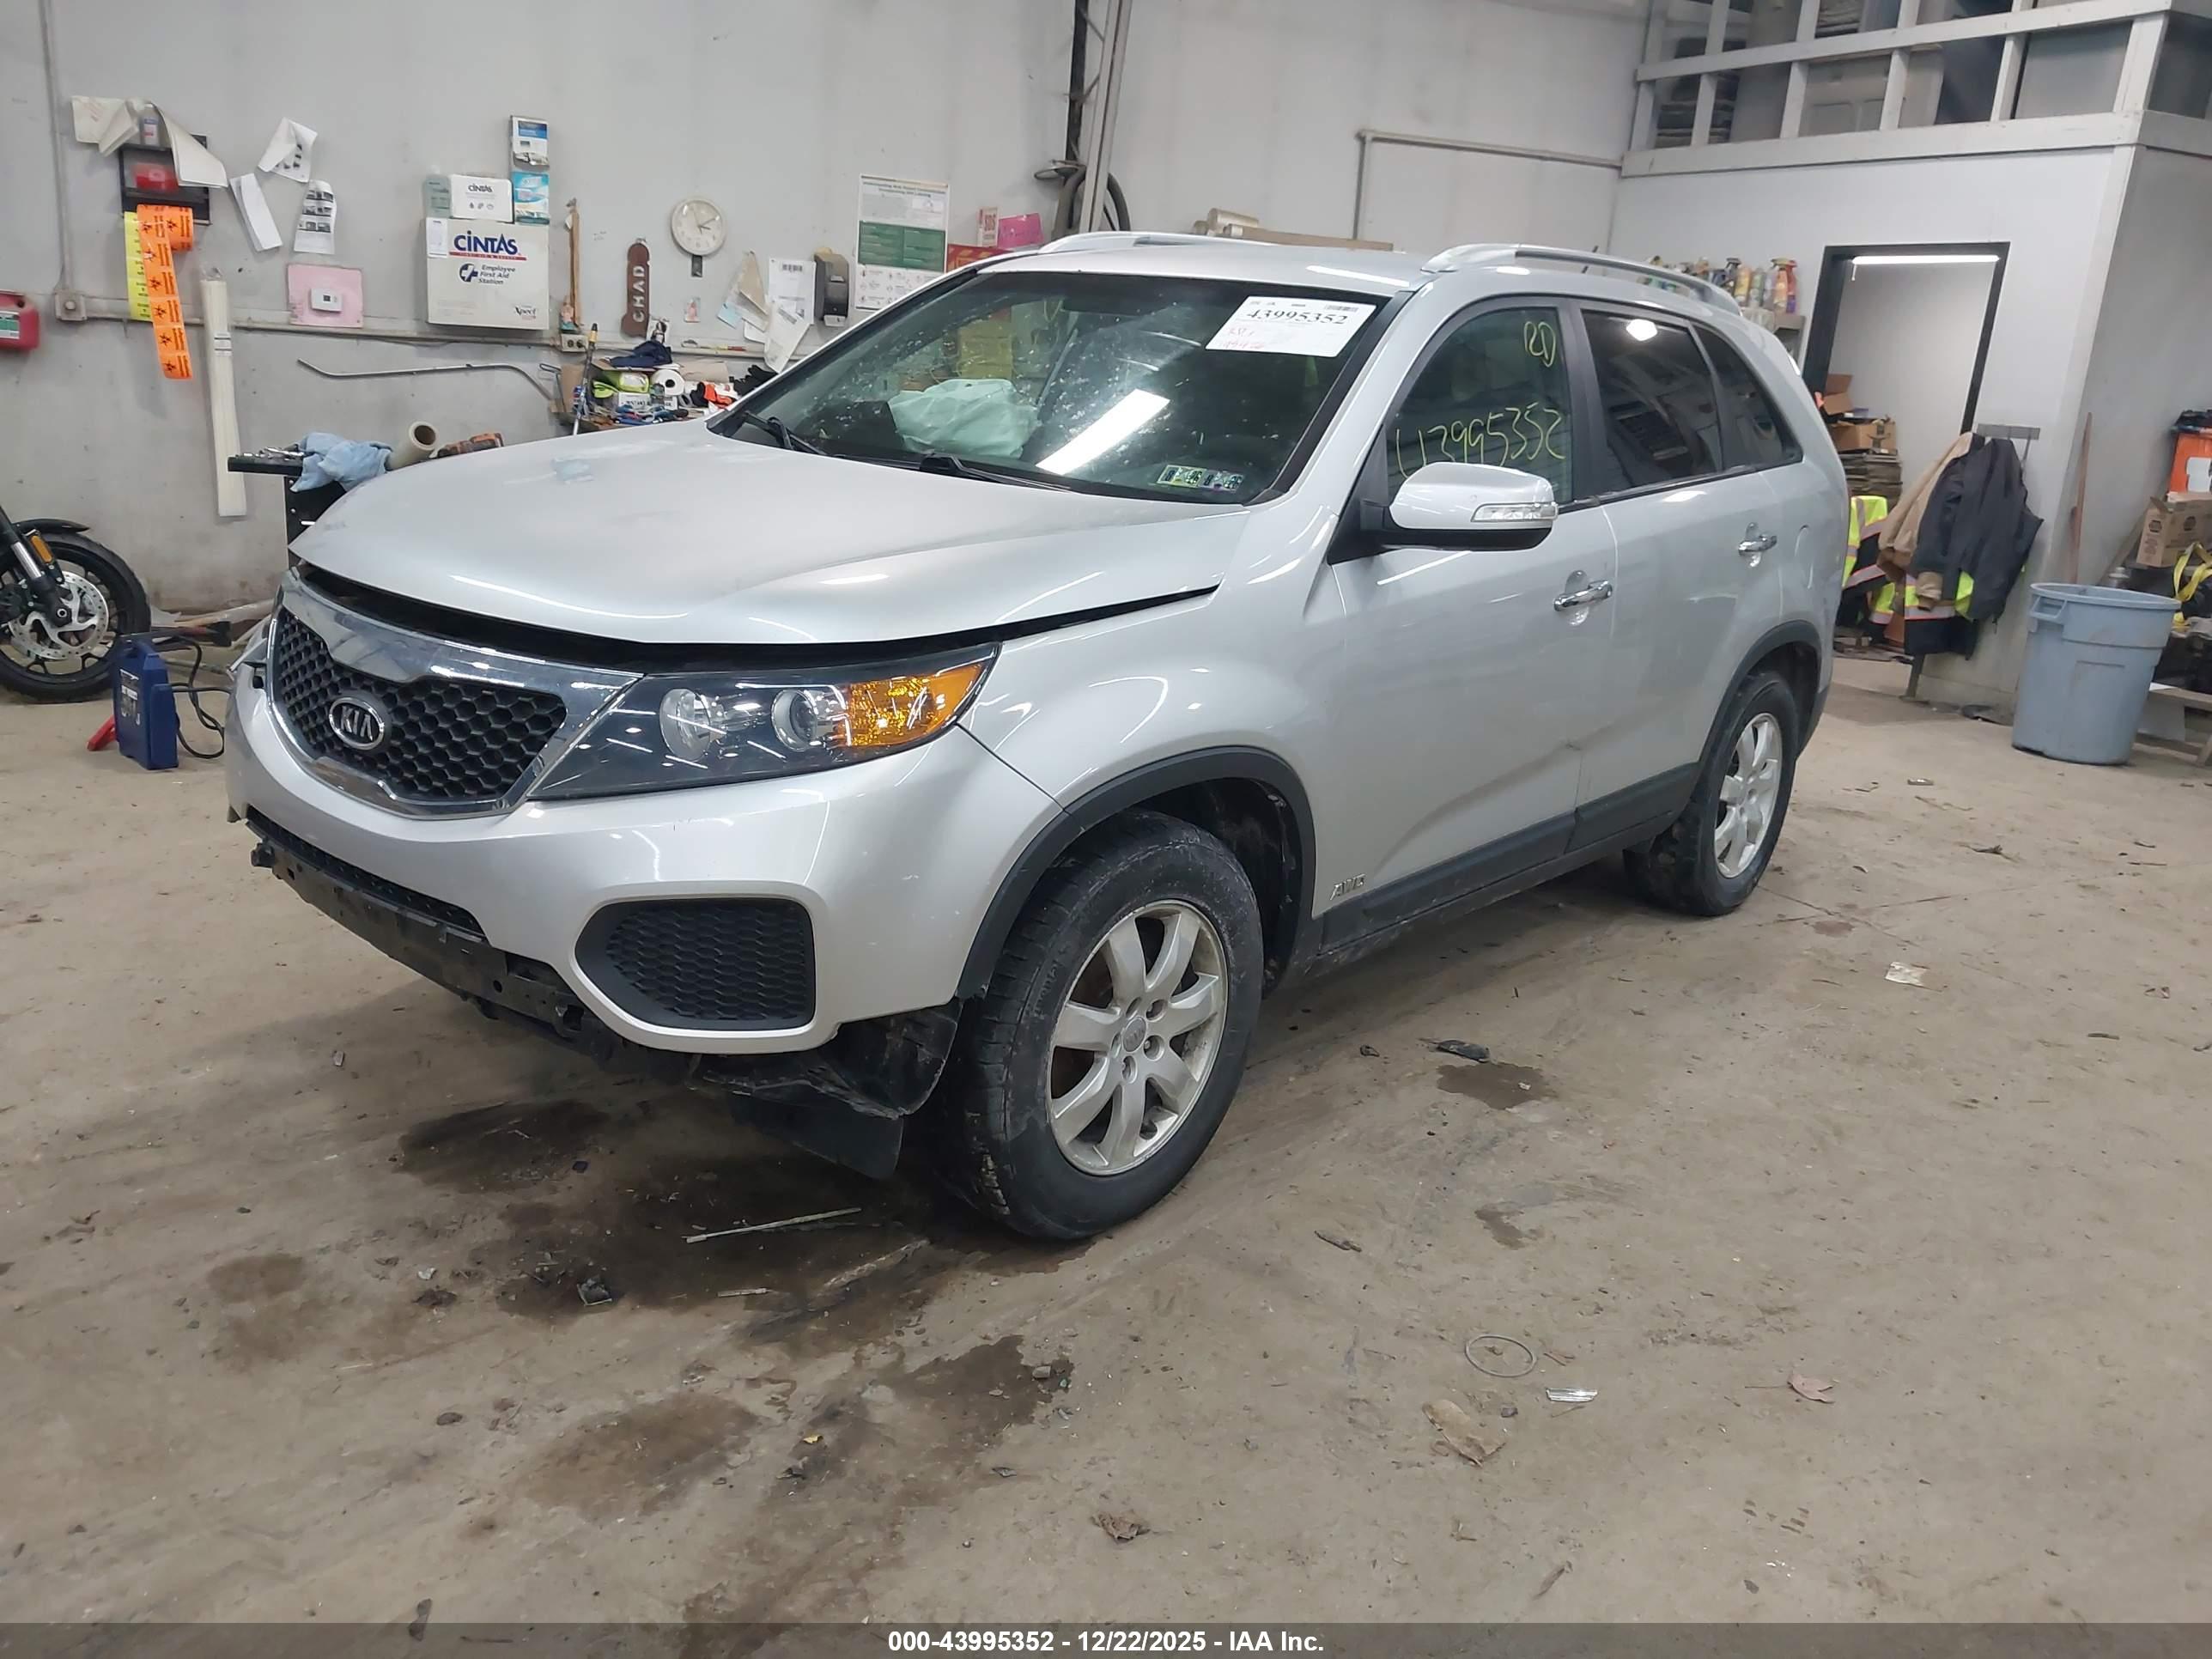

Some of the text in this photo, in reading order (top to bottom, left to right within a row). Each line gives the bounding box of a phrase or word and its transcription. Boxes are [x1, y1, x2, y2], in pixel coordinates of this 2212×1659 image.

[481, 264, 516, 273] Employee
[632, 265, 645, 323] CHAD
[1247, 309, 1348, 325] 43995352
[339, 706, 374, 741] KIA
